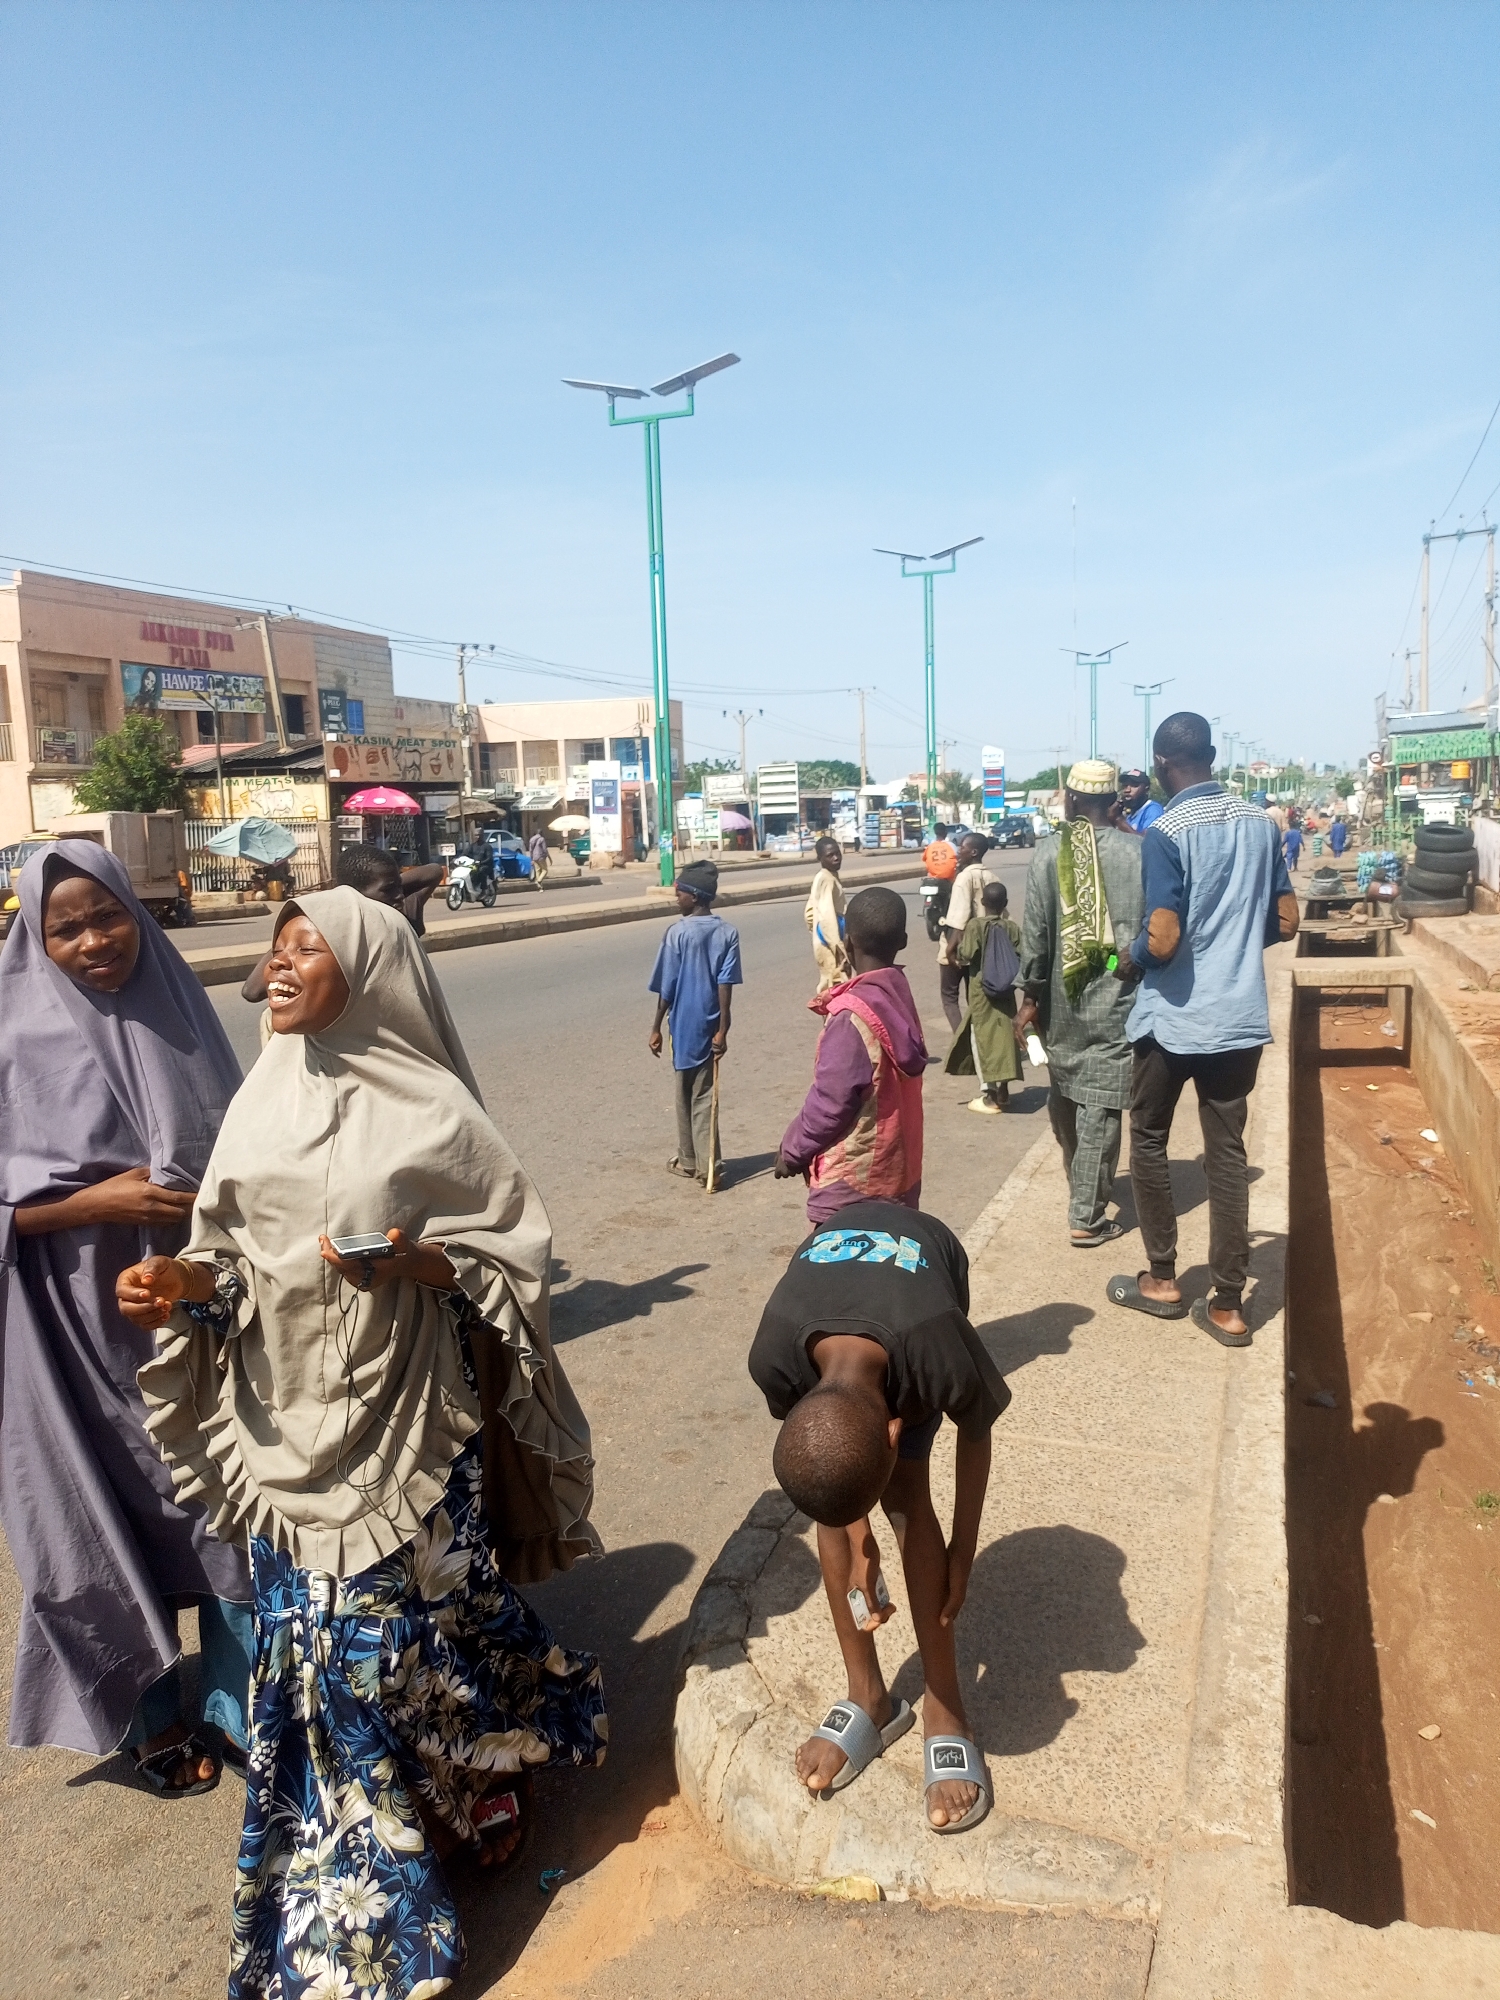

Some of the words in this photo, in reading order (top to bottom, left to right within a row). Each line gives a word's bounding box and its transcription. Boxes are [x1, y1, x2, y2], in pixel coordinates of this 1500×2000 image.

[397, 738, 426, 748] MEAT
[431, 740, 457, 748] SPOT
[244, 777, 279, 787] MEAT
[284, 775, 319, 785] SPOT
